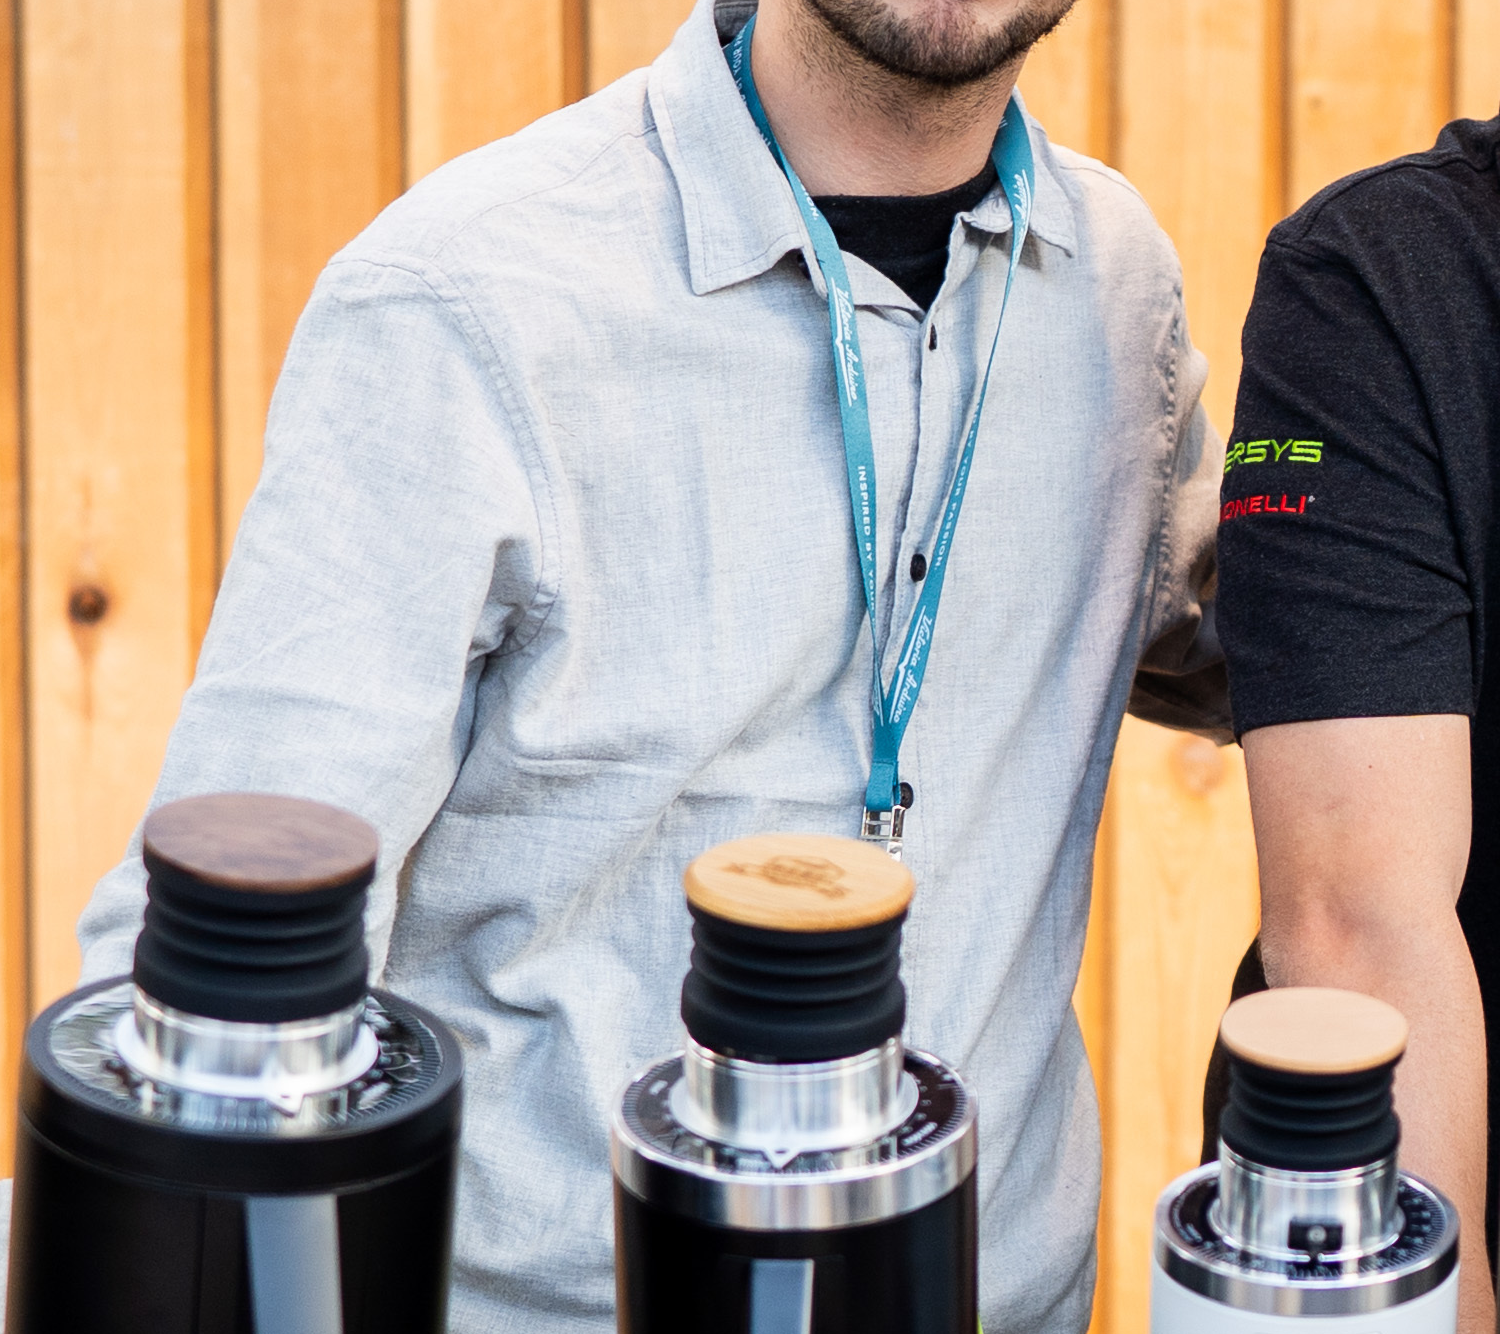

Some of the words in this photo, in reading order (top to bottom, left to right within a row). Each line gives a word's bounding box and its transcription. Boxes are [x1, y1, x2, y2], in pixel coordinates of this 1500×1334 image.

[836, 286, 853, 341] Victoria
[845, 342, 860, 401] Arduino
[955, 456, 970, 497] YOUR
[857, 465, 871, 537] INSPIRED
[865, 542, 874, 562] BY
[1220, 493, 1307, 524] ONELLI
[909, 614, 933, 667] Victoria
[893, 669, 918, 724] Arduino
